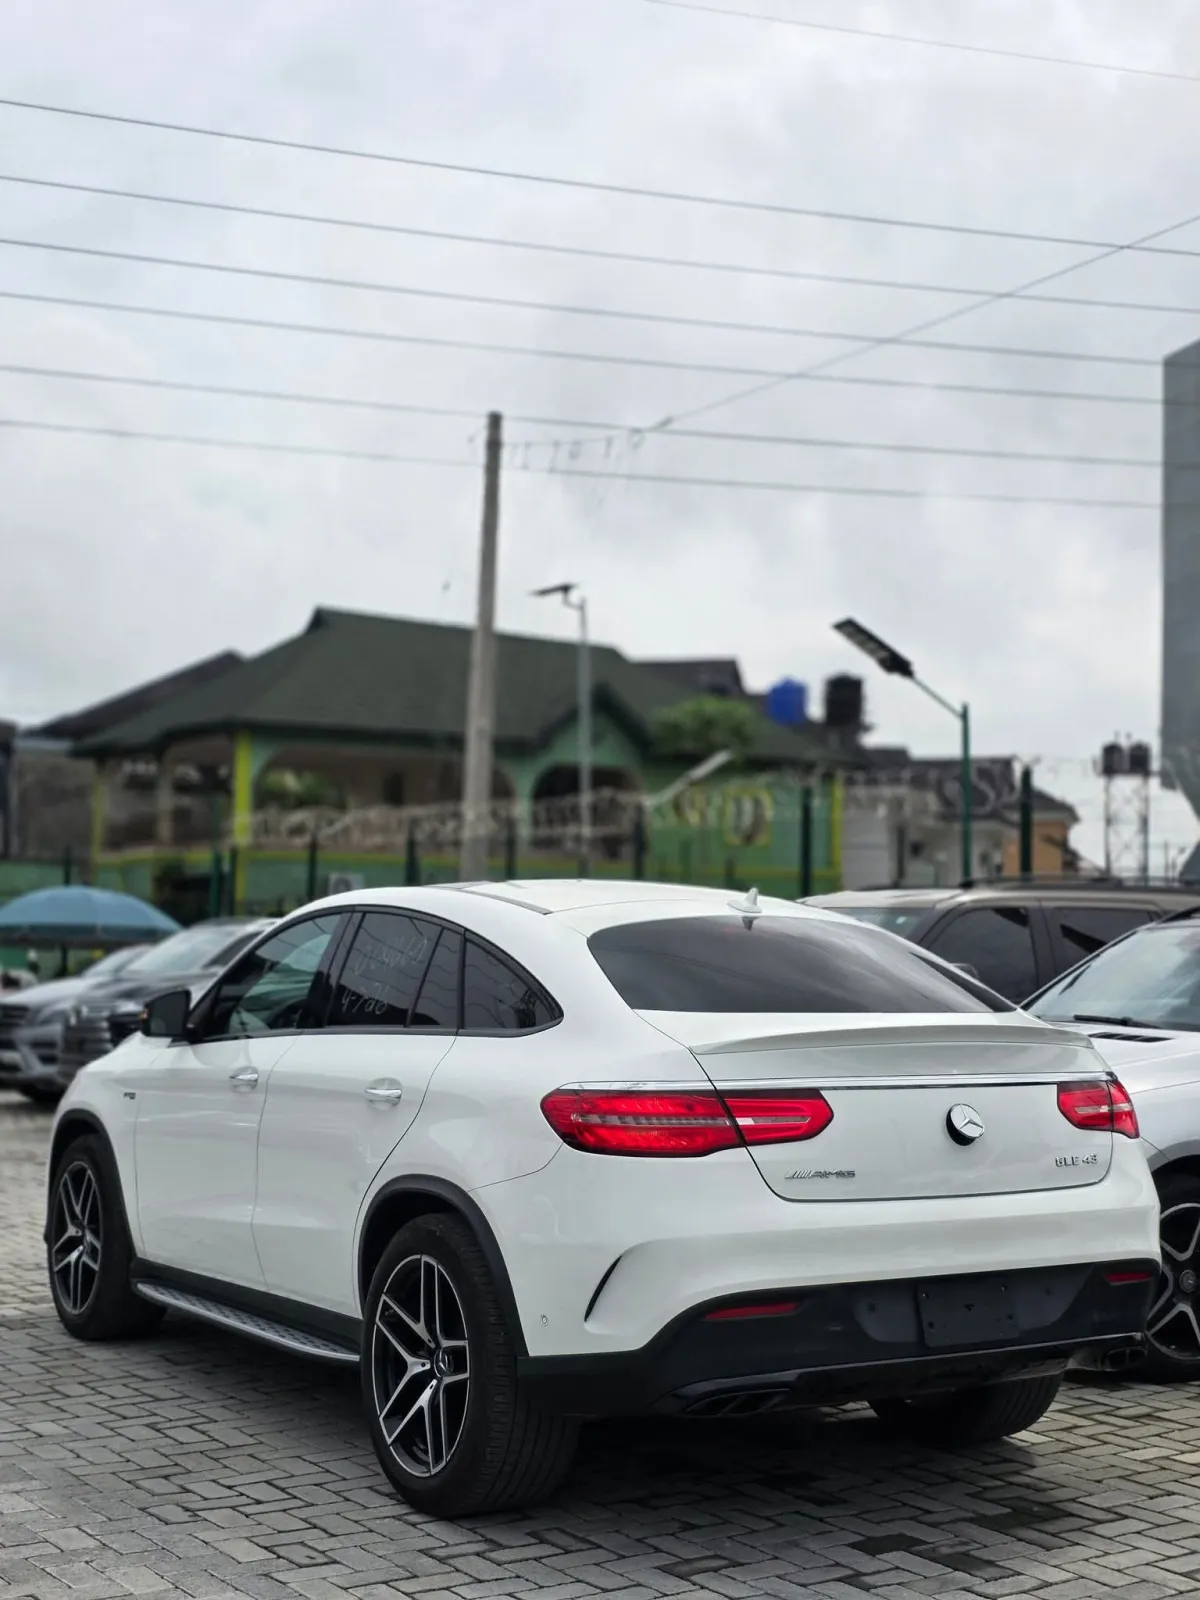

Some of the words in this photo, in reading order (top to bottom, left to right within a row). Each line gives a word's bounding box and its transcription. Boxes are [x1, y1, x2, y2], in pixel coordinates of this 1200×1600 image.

[1055, 1156, 1080, 1167] GLE
[1081, 1153, 1099, 1165] 43
[806, 1168, 856, 1180] AMG
